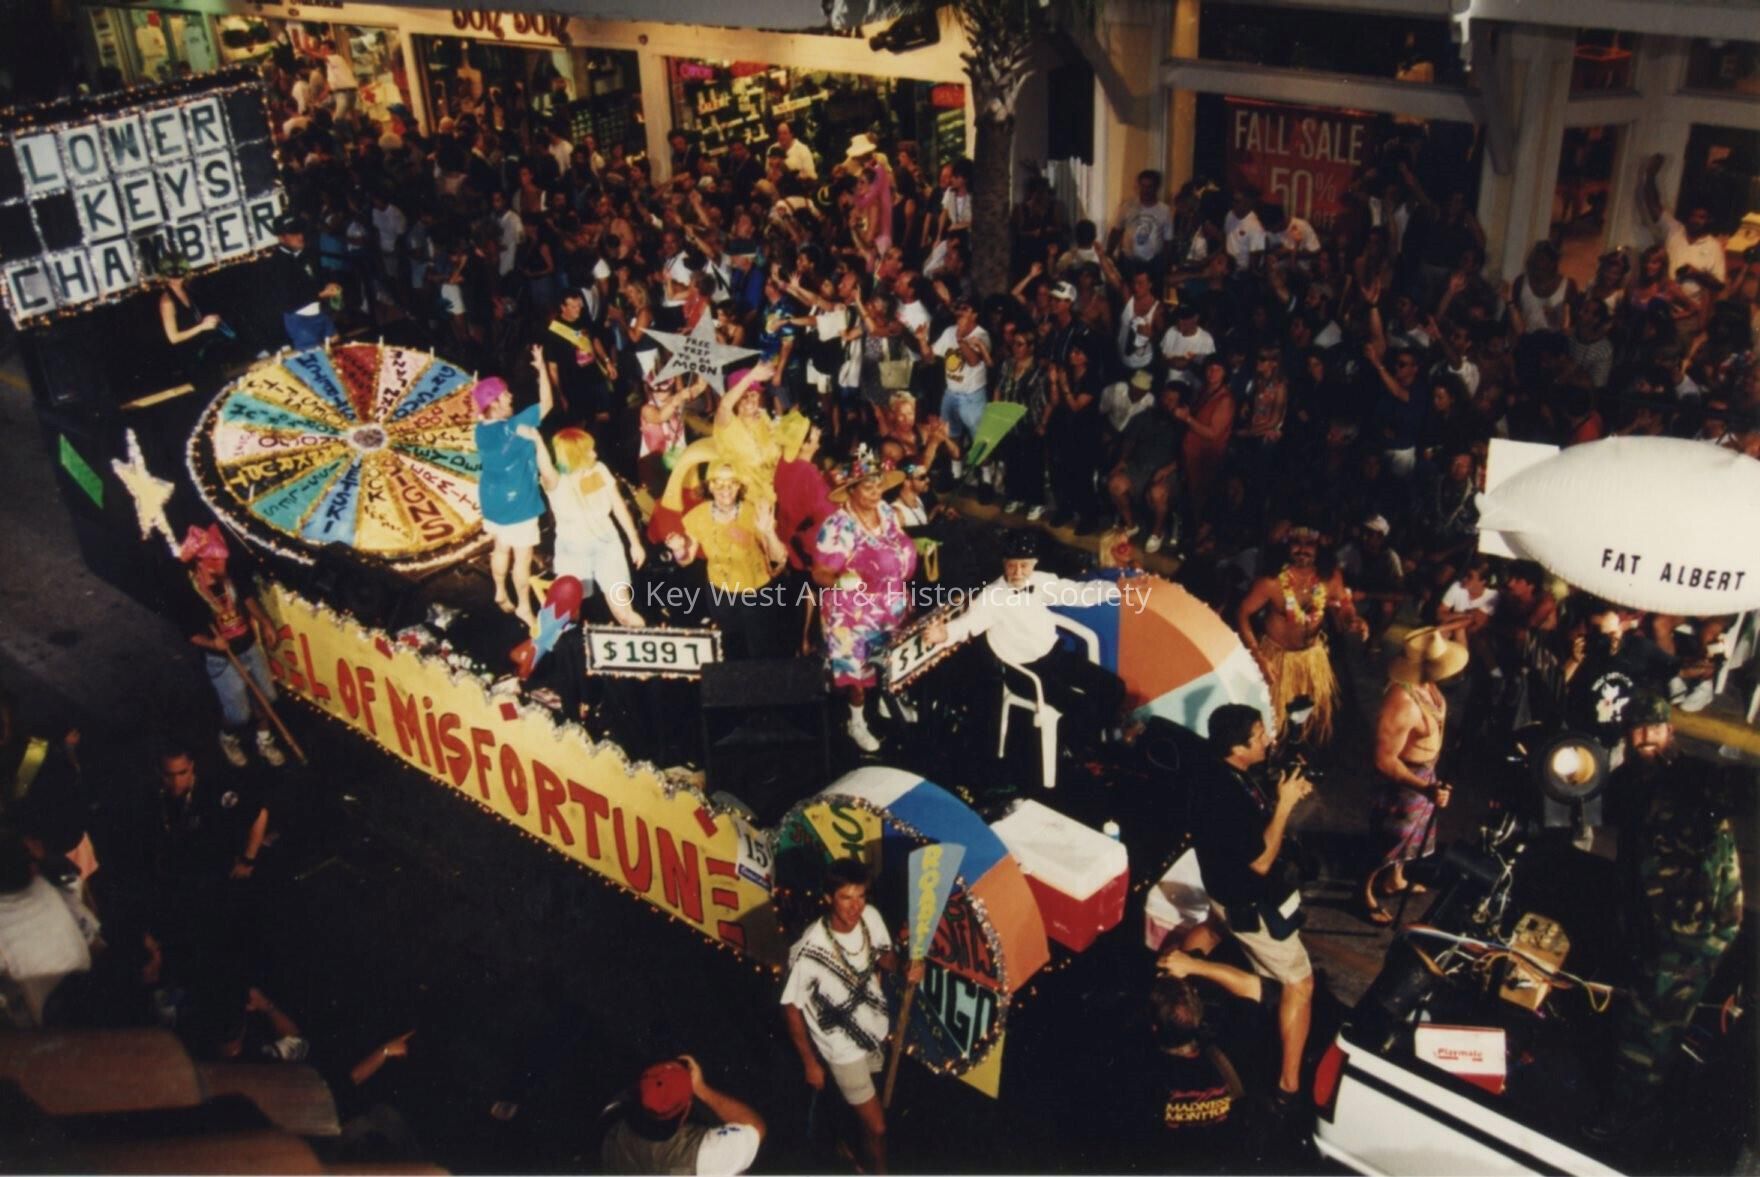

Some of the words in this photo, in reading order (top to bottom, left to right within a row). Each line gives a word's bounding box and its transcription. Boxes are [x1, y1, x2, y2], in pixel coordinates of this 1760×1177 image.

[21, 104, 220, 185] LOWER
[1235, 110, 1290, 155] FALL
[1301, 117, 1365, 166] SALE
[82, 159, 232, 232] KEYS
[11, 201, 279, 311] CHAMBER
[672, 360, 717, 376] MOON
[686, 337, 710, 349] FREE
[382, 459, 454, 542] SIGNS
[1601, 548, 1642, 575] FAT
[1660, 562, 1746, 591] ALBERT
[603, 640, 700, 665] $1997
[337, 658, 377, 736] OF
[744, 833, 768, 868] 15
